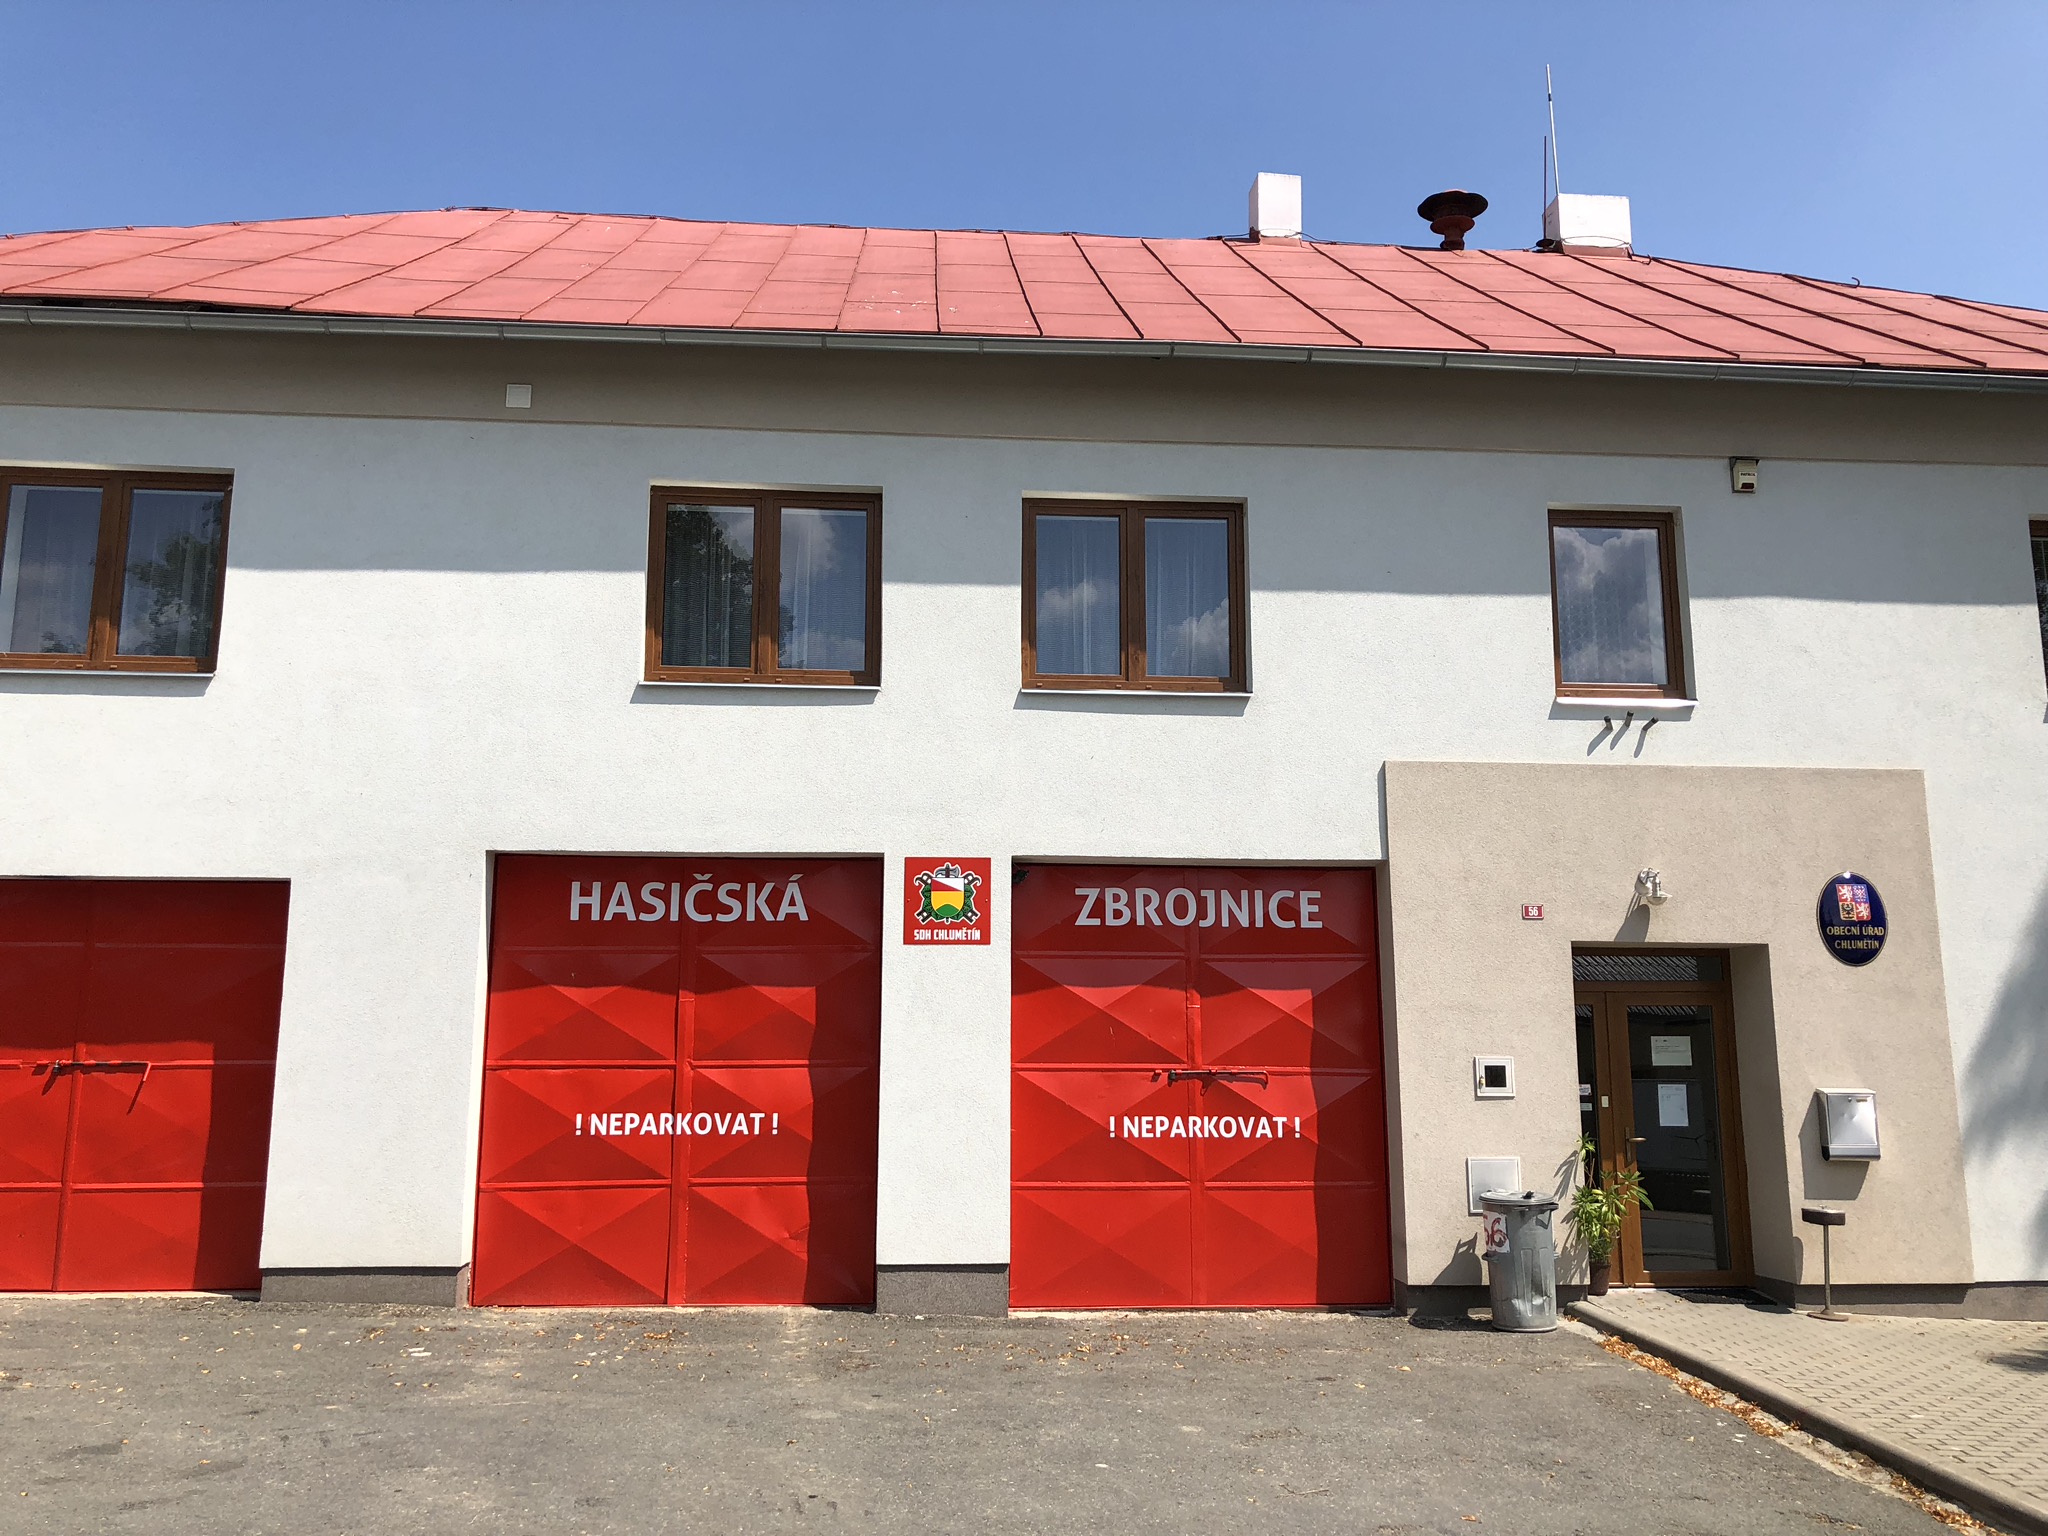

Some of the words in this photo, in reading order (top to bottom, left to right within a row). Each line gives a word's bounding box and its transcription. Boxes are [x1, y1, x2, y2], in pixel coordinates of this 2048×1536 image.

[570, 873, 809, 922] HASIČSKÁ
[1074, 887, 1323, 928] ZBROJNICE
[1528, 906, 1539, 917] 56
[913, 929, 931, 941] SDH
[933, 926, 981, 941] CHLUMĚTÍN
[1826, 924, 1860, 935] OBECNÍ
[1862, 924, 1885, 936] ÚŘAD
